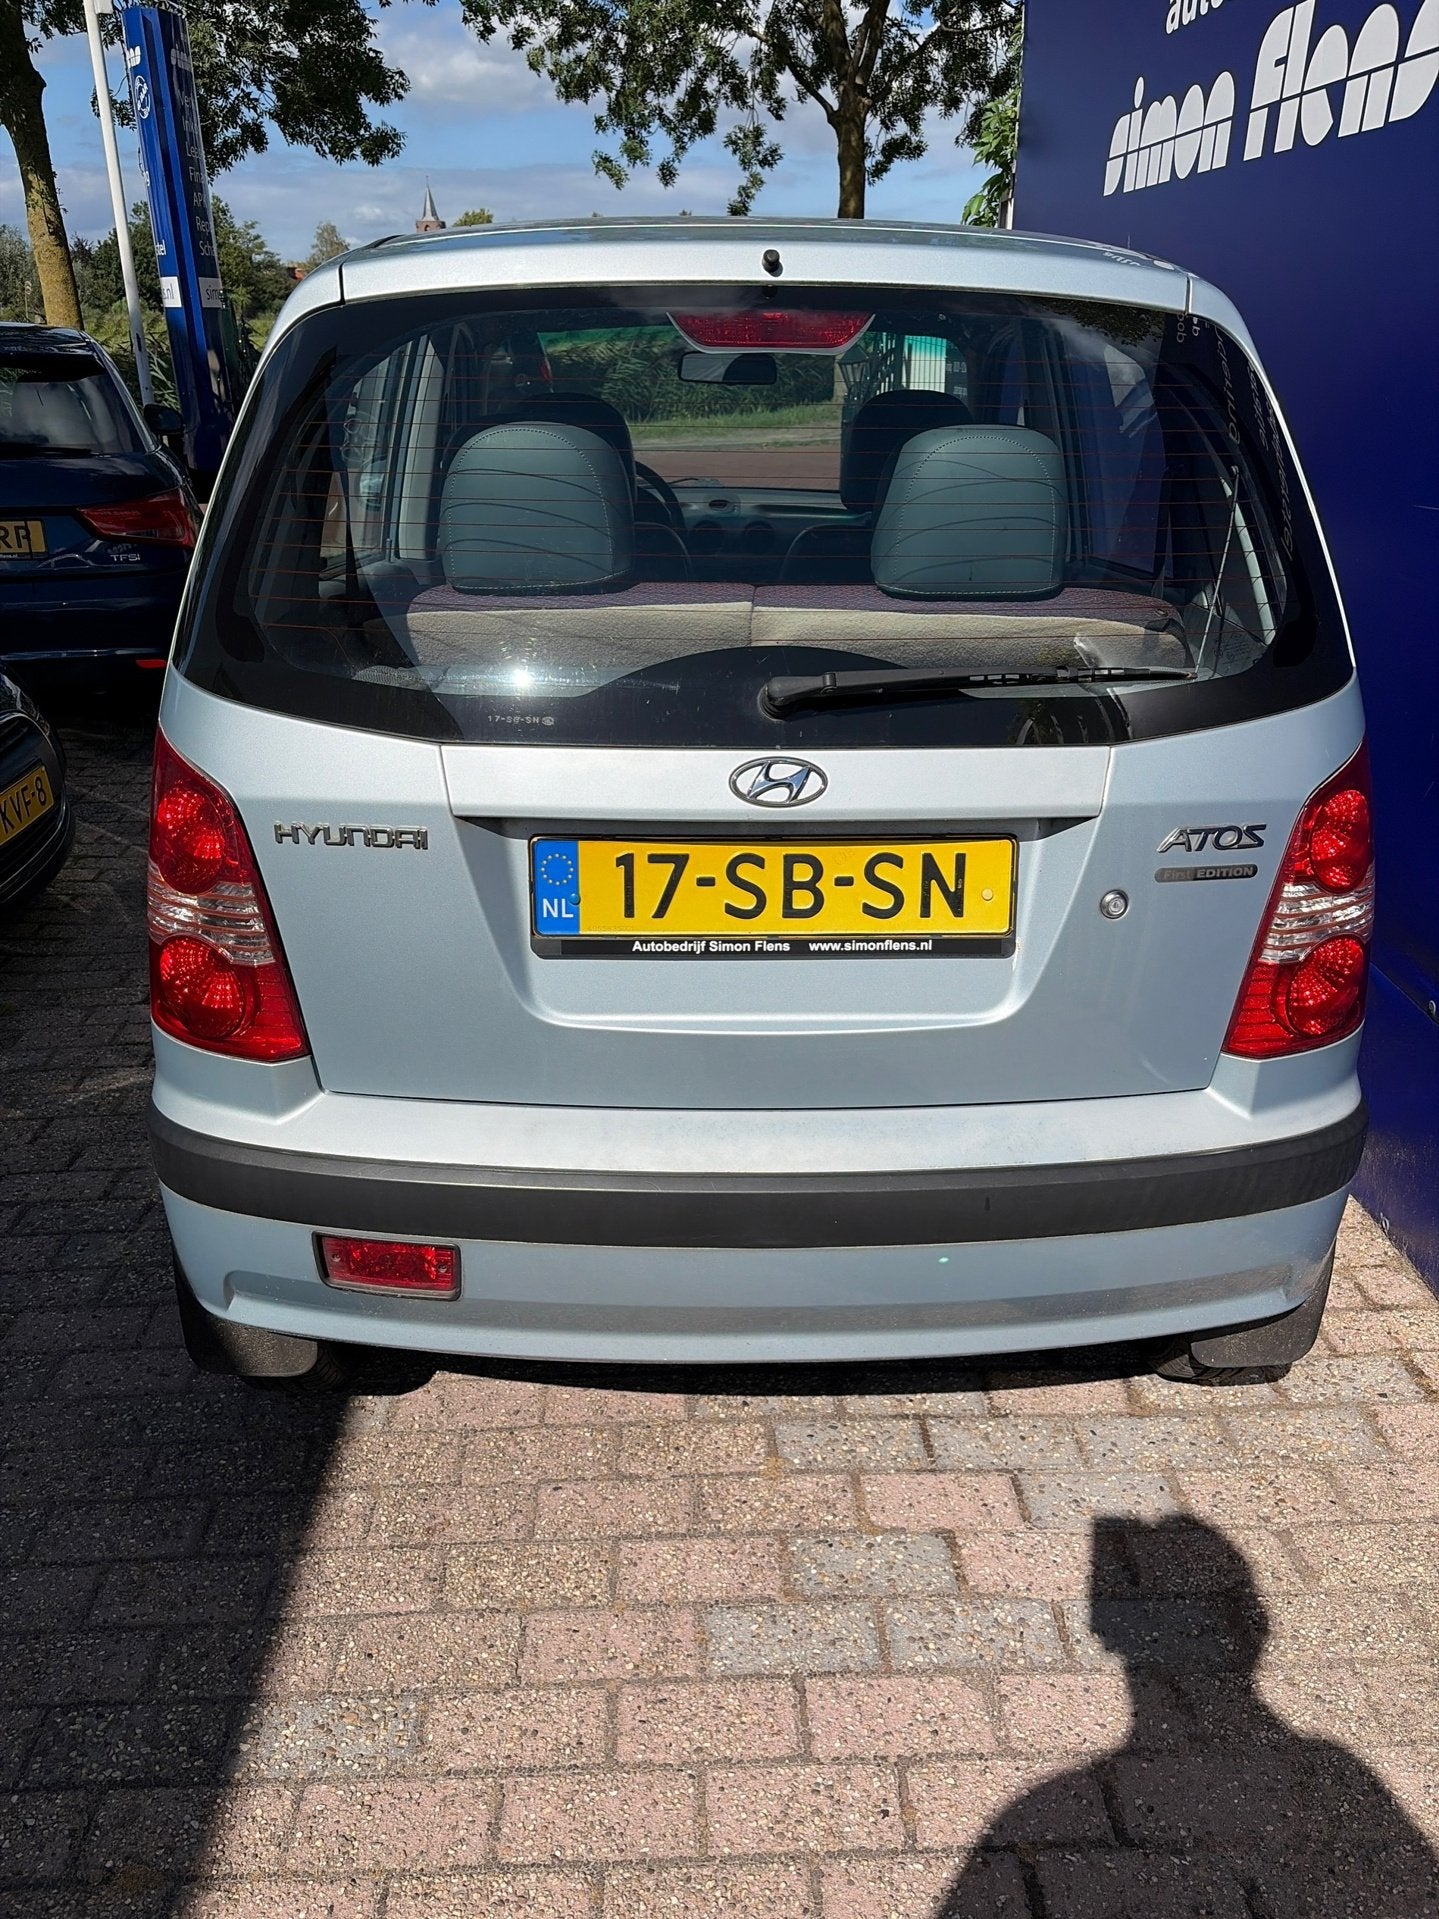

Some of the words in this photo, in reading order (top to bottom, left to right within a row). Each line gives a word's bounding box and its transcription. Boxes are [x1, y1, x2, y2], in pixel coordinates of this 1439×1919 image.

[273, 820, 429, 850] HYUNDAI
[1156, 823, 1268, 853] ATOS
[542, 898, 575, 919] NL
[615, 852, 967, 919] 17-SB-SN
[1196, 866, 1254, 879] EDITION
[632, 940, 704, 955] Autobedrijf
[709, 940, 751, 952] Simon
[754, 940, 791, 952] Flens
[808, 940, 933, 952] www.simonflens.nl
